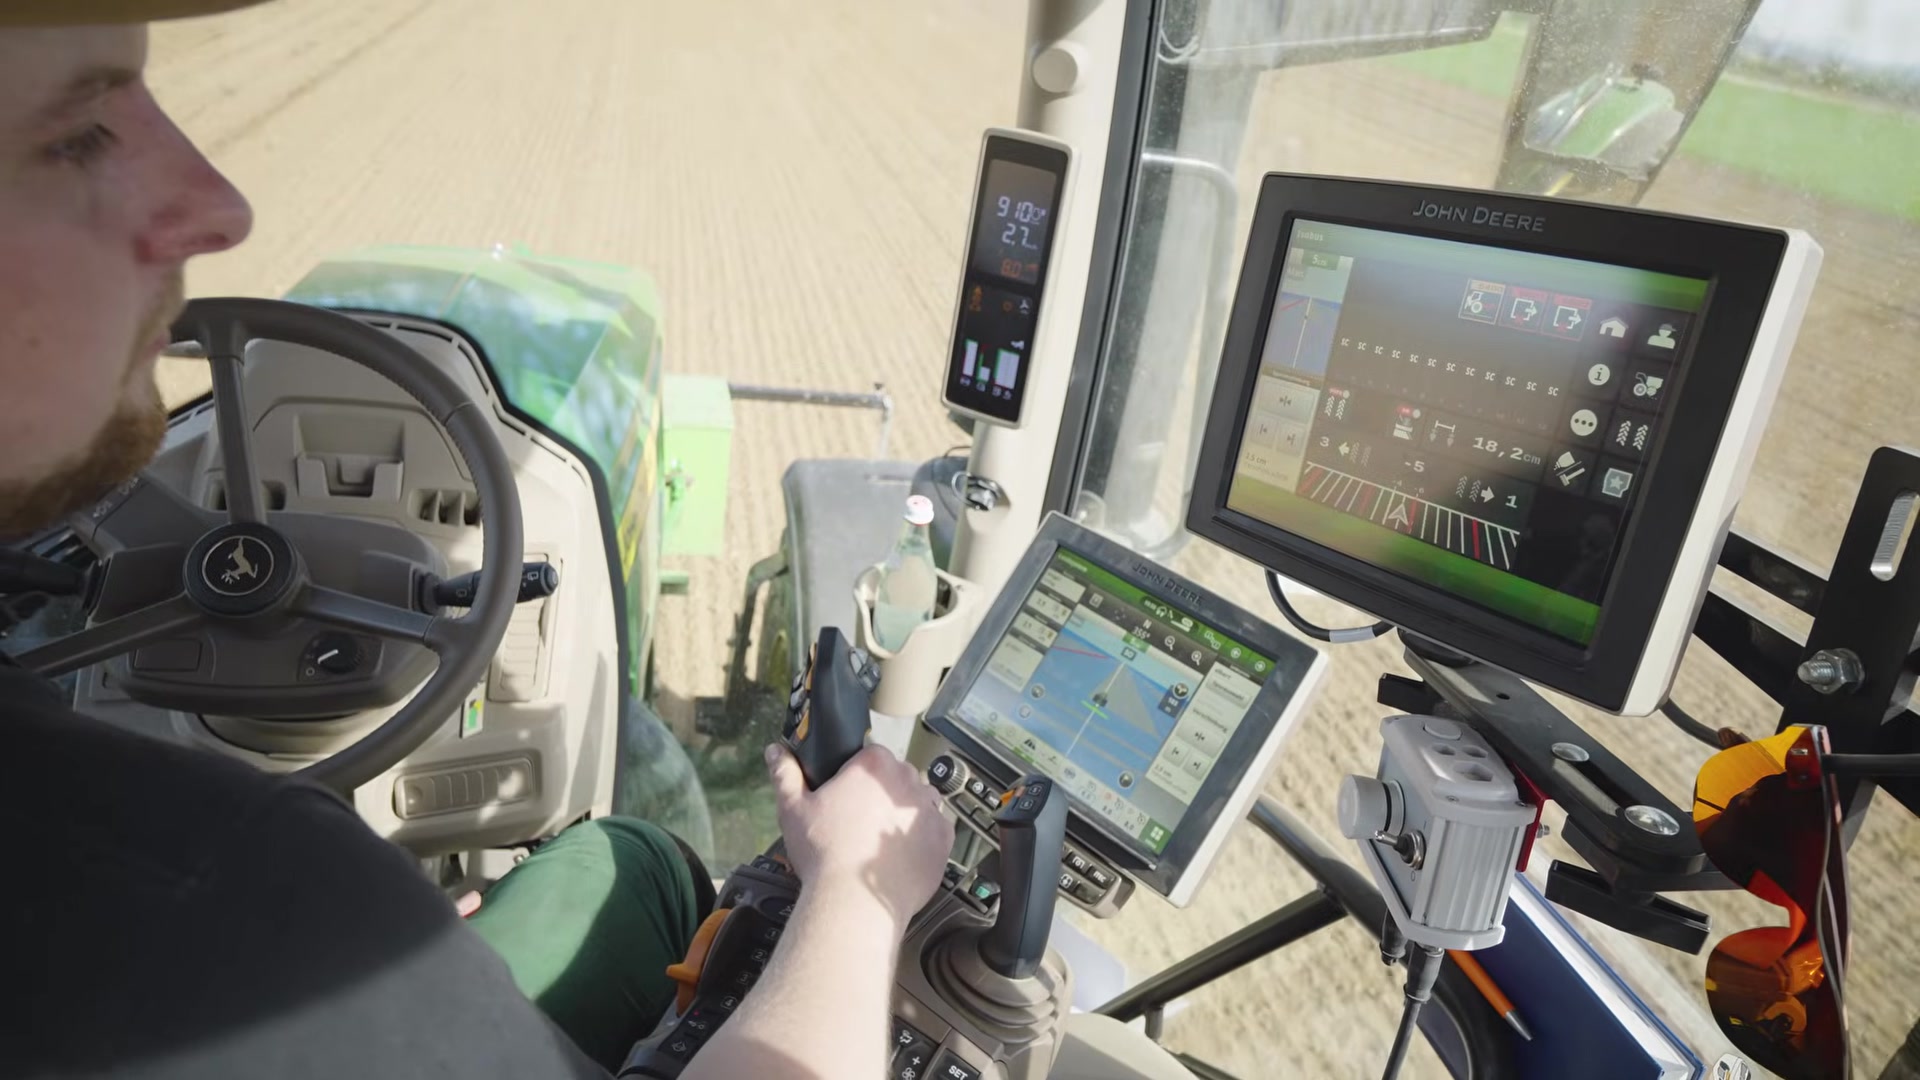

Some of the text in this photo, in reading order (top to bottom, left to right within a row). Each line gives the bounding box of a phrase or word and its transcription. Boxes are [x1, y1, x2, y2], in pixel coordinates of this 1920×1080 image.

[1413, 200, 1546, 232] JOHN DEERE
[1319, 436, 1330, 447] 3
[1505, 495, 1518, 509] 1
[1132, 562, 1203, 606] JOHN DEERE
[948, 1065, 968, 1080] SET
